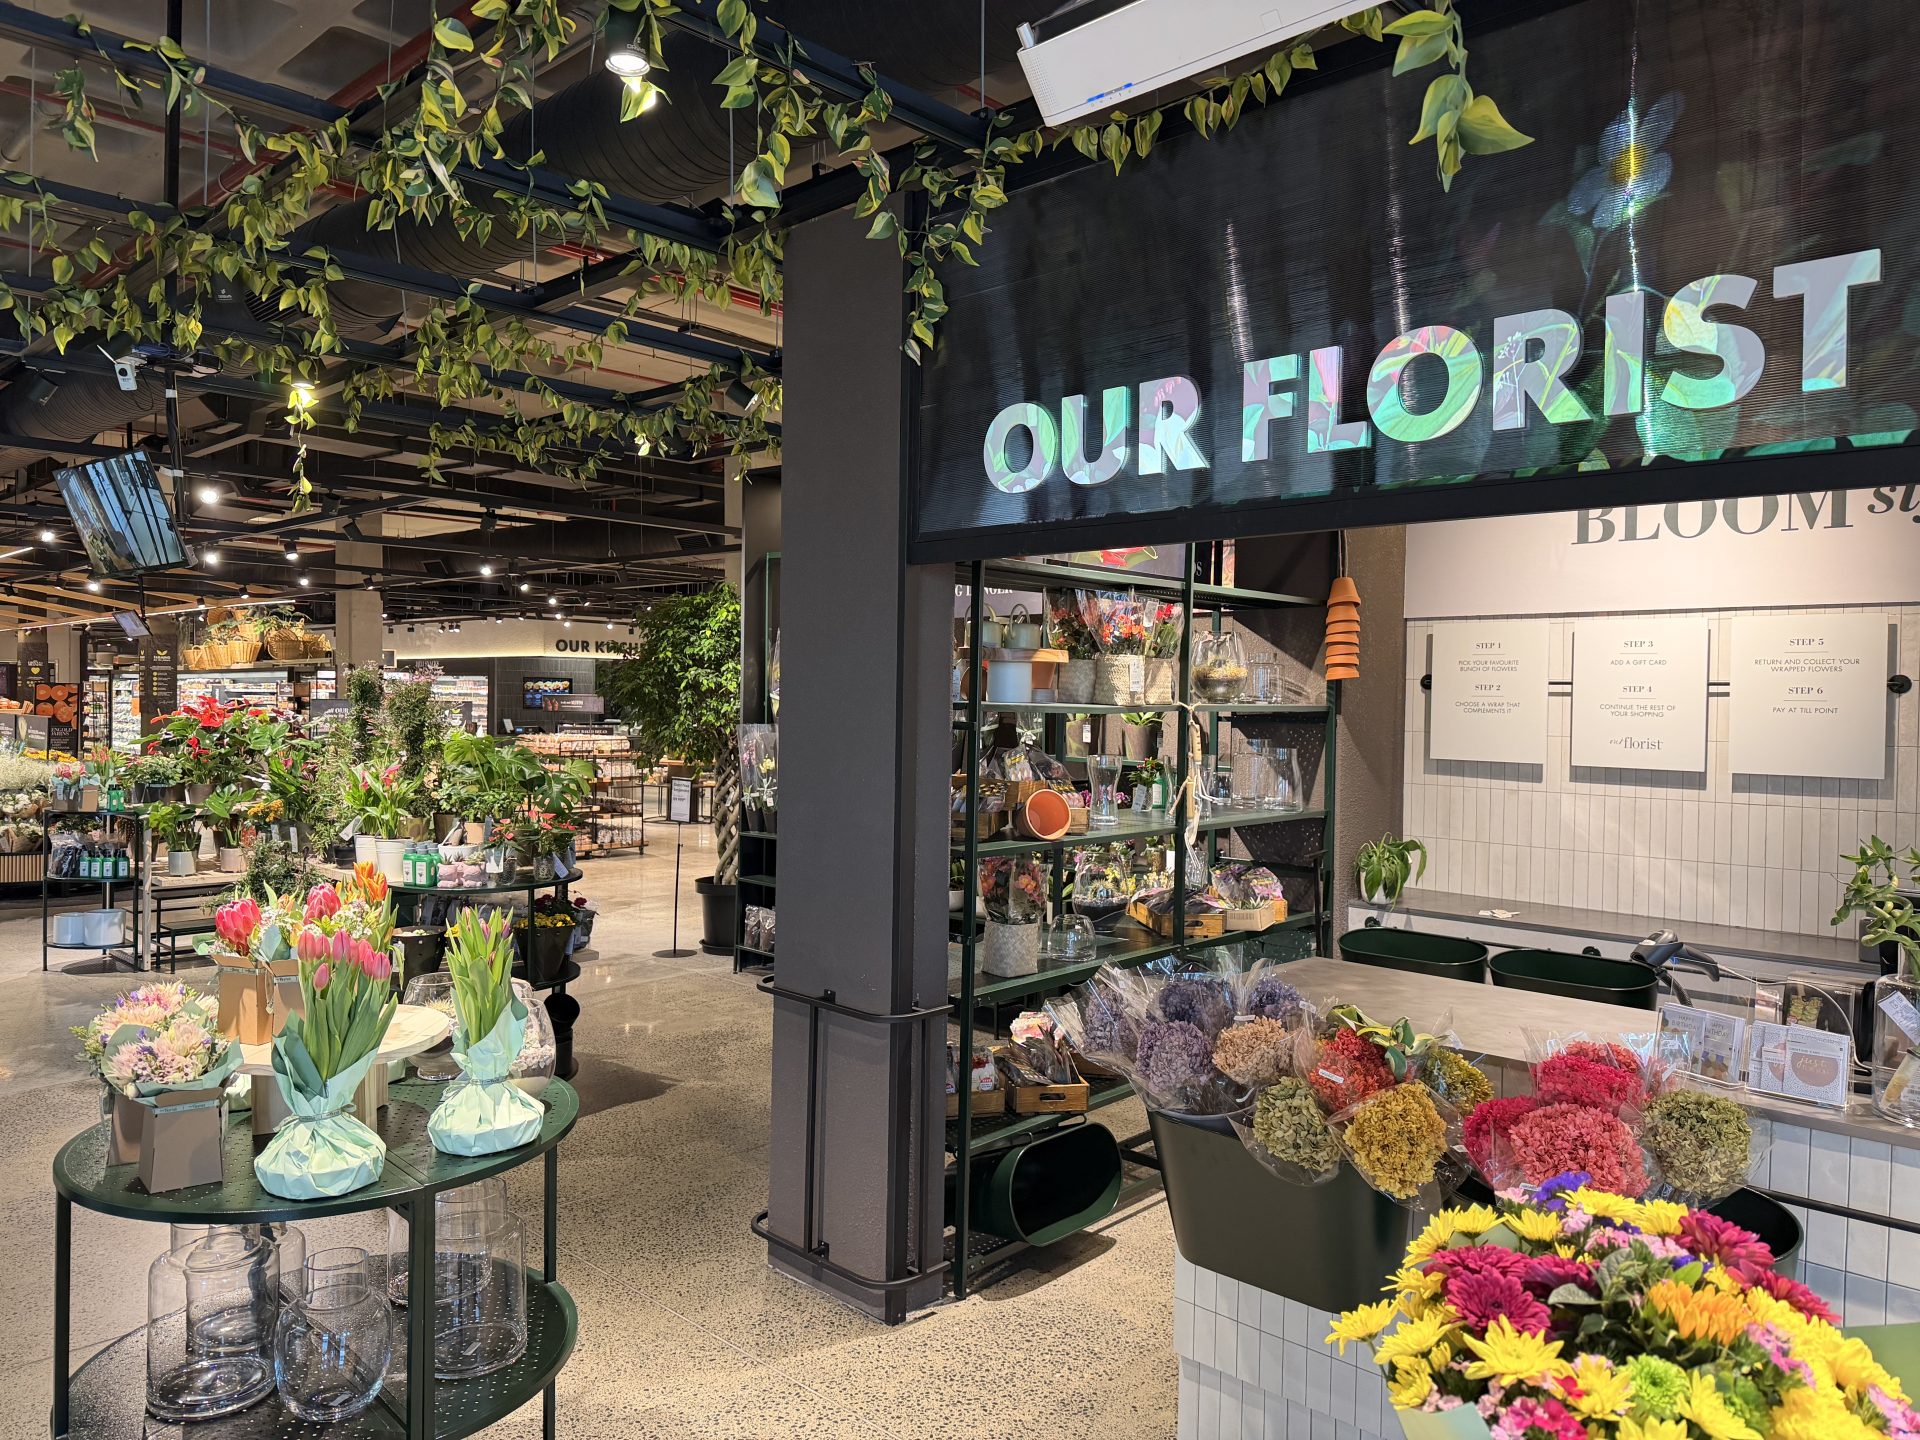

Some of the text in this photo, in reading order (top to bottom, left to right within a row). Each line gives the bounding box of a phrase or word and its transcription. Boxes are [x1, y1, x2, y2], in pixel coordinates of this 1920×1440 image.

[983, 249, 1881, 494] OUR FLORIST
[1571, 490, 1854, 546] BLOOM
[556, 639, 590, 653] OUR
[1475, 642, 1495, 650] STEP
[1623, 640, 1654, 648] STEP 3
[1789, 638, 1825, 646] STEP 5
[1610, 659, 1667, 667] ADD A GIFT CARD
[1754, 658, 1782, 666] RETURN
[1784, 658, 1801, 666] AND
[1803, 658, 1835, 666] COLLECT
[1770, 665, 1843, 673] WRAPPED FLOWERS
[1474, 683, 1501, 691] STEP 2
[1622, 685, 1653, 693] STEP 4
[1788, 686, 1824, 695] STEP 6
[1507, 707, 1512, 715] IT
[1636, 703, 1648, 711] THE
[1649, 704, 1665, 712] REST
[1666, 704, 1676, 712] OF
[1629, 711, 1665, 719] SHOPPING
[1624, 736, 1664, 750] florist
